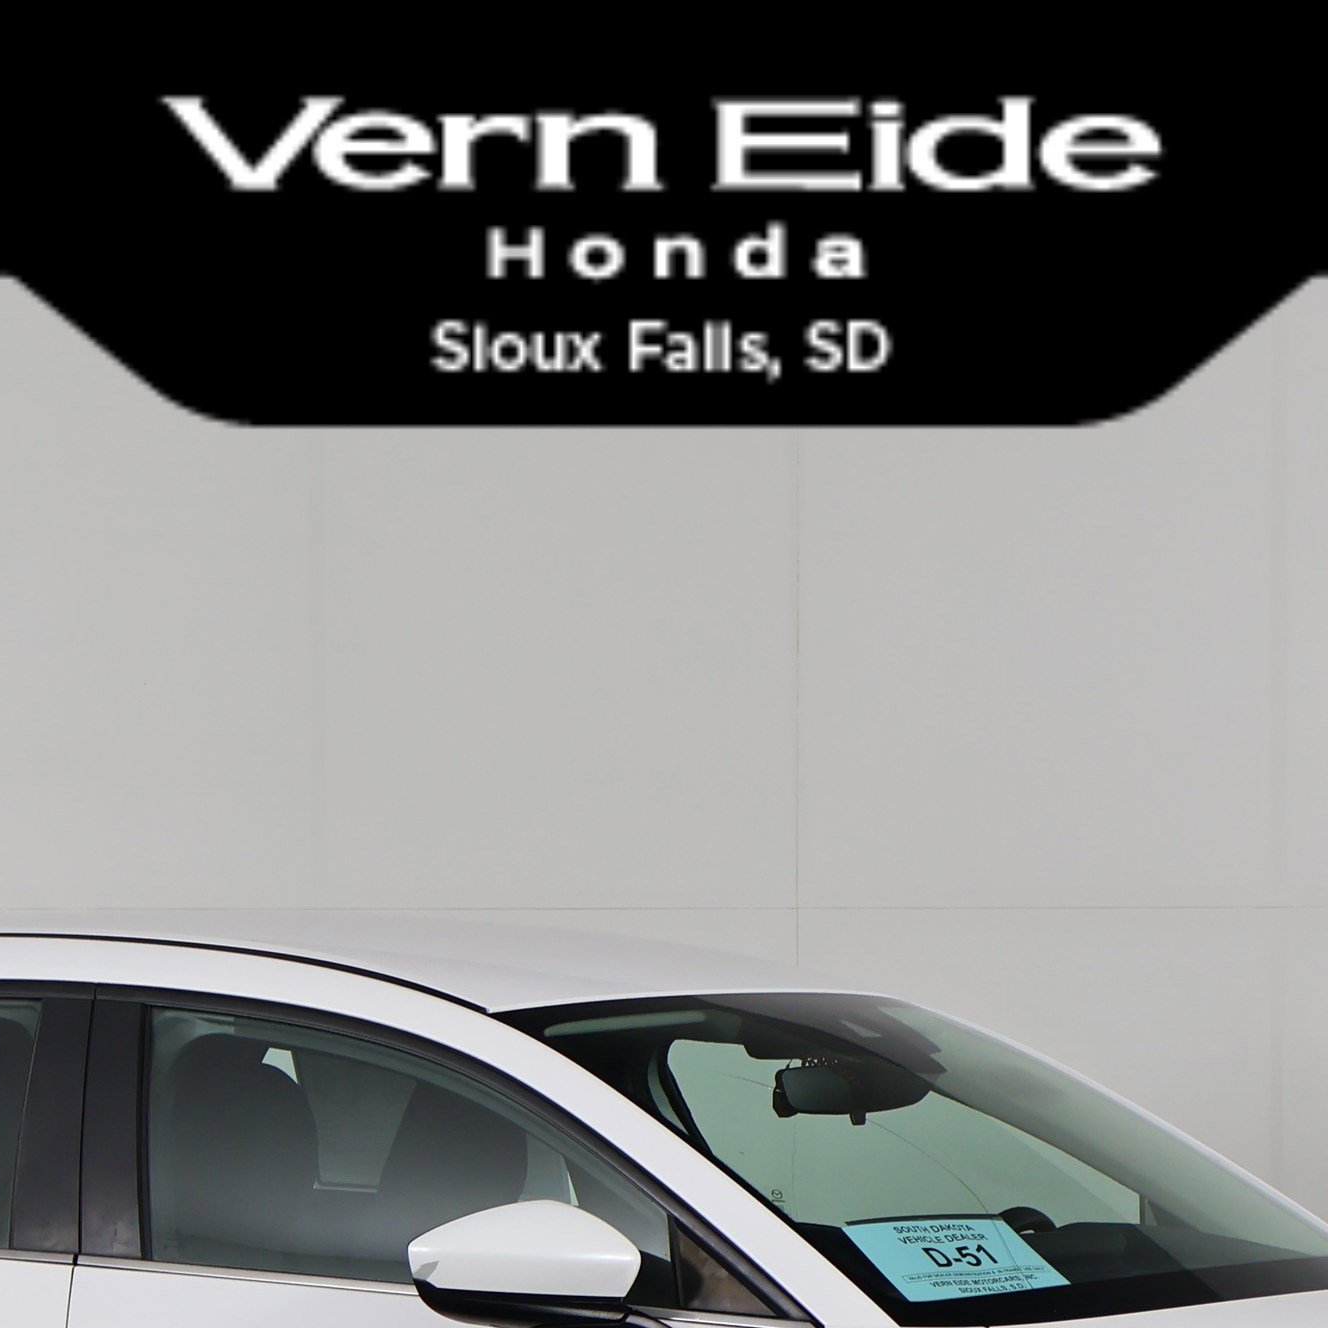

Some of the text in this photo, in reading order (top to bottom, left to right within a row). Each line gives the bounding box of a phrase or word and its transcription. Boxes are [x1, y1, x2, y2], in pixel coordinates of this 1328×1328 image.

[893, 1224, 975, 1234] SOUTH DAKOTA
[897, 1233, 989, 1245] VEHICLE DEALER
[922, 1244, 998, 1269] D-51
[929, 1280, 953, 1288] VERN
